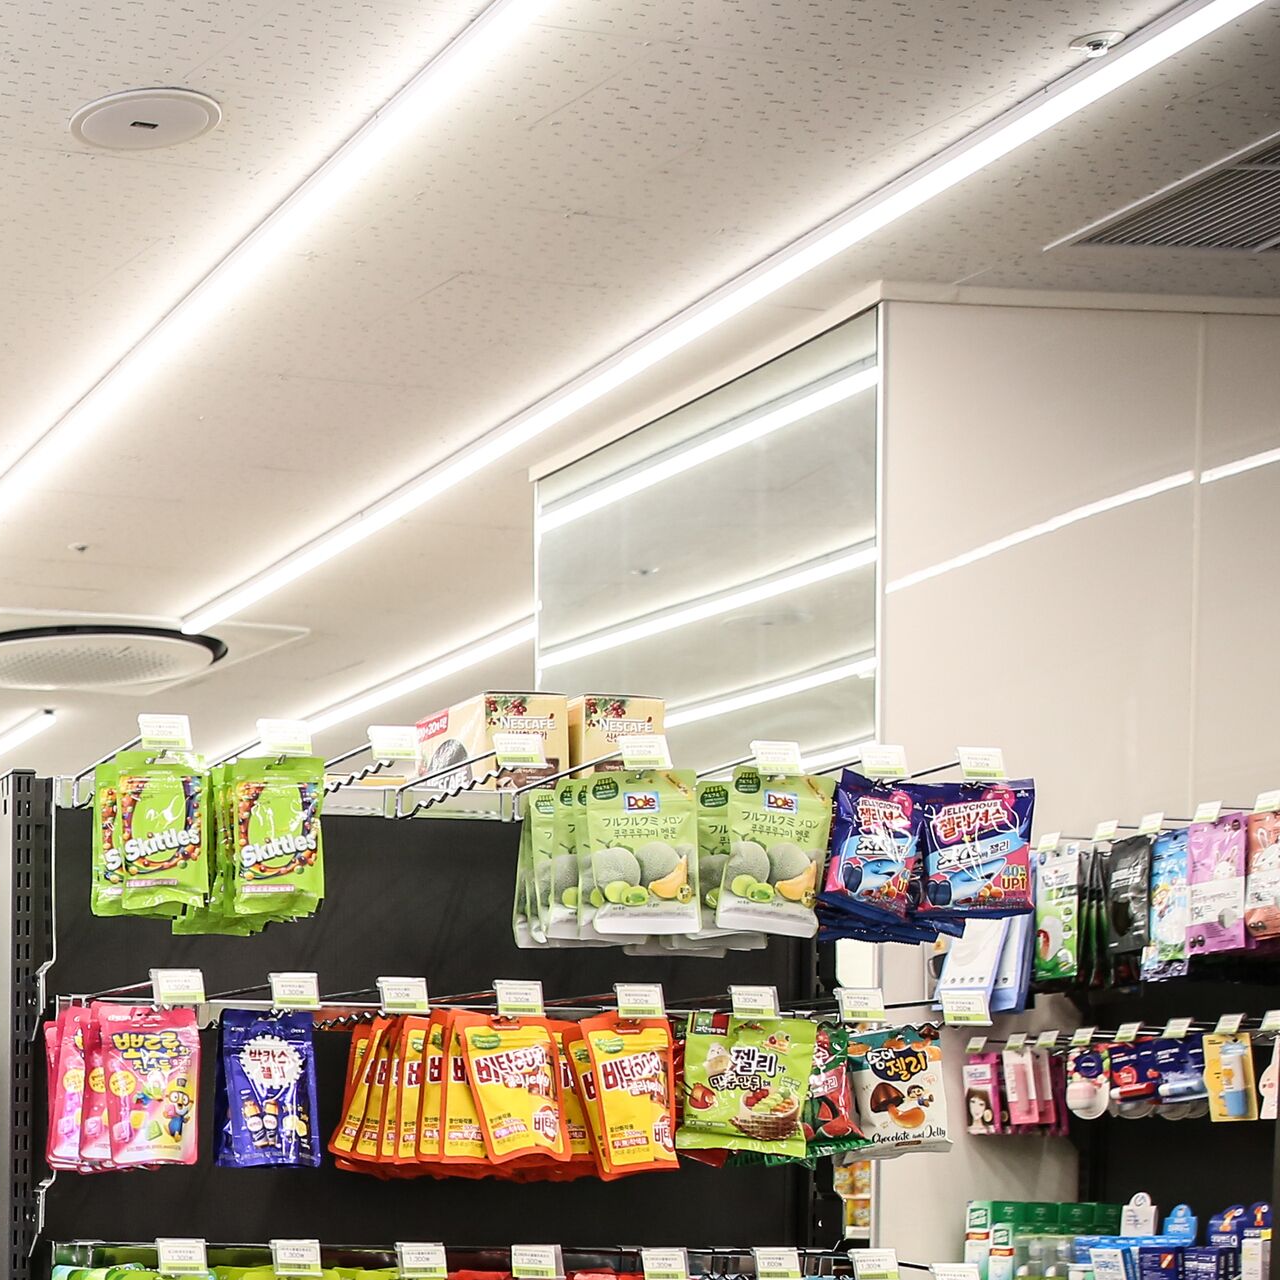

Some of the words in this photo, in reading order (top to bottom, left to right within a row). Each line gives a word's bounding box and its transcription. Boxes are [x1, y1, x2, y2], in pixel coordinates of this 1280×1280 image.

[626, 796, 657, 810] Dole
[767, 794, 795, 808] Dole
[943, 802, 999, 816] JELLYCIOUS
[124, 827, 200, 861] Skittles
[240, 833, 317, 867] Skittles
[249, 1048, 290, 1065] 박카스
[475, 1046, 545, 1083] 비타500
[886, 1053, 926, 1081] 젤리
[601, 1051, 661, 1089] 비타500
[872, 1132, 910, 1144] Chocolate
[924, 1125, 946, 1139] Jelly
